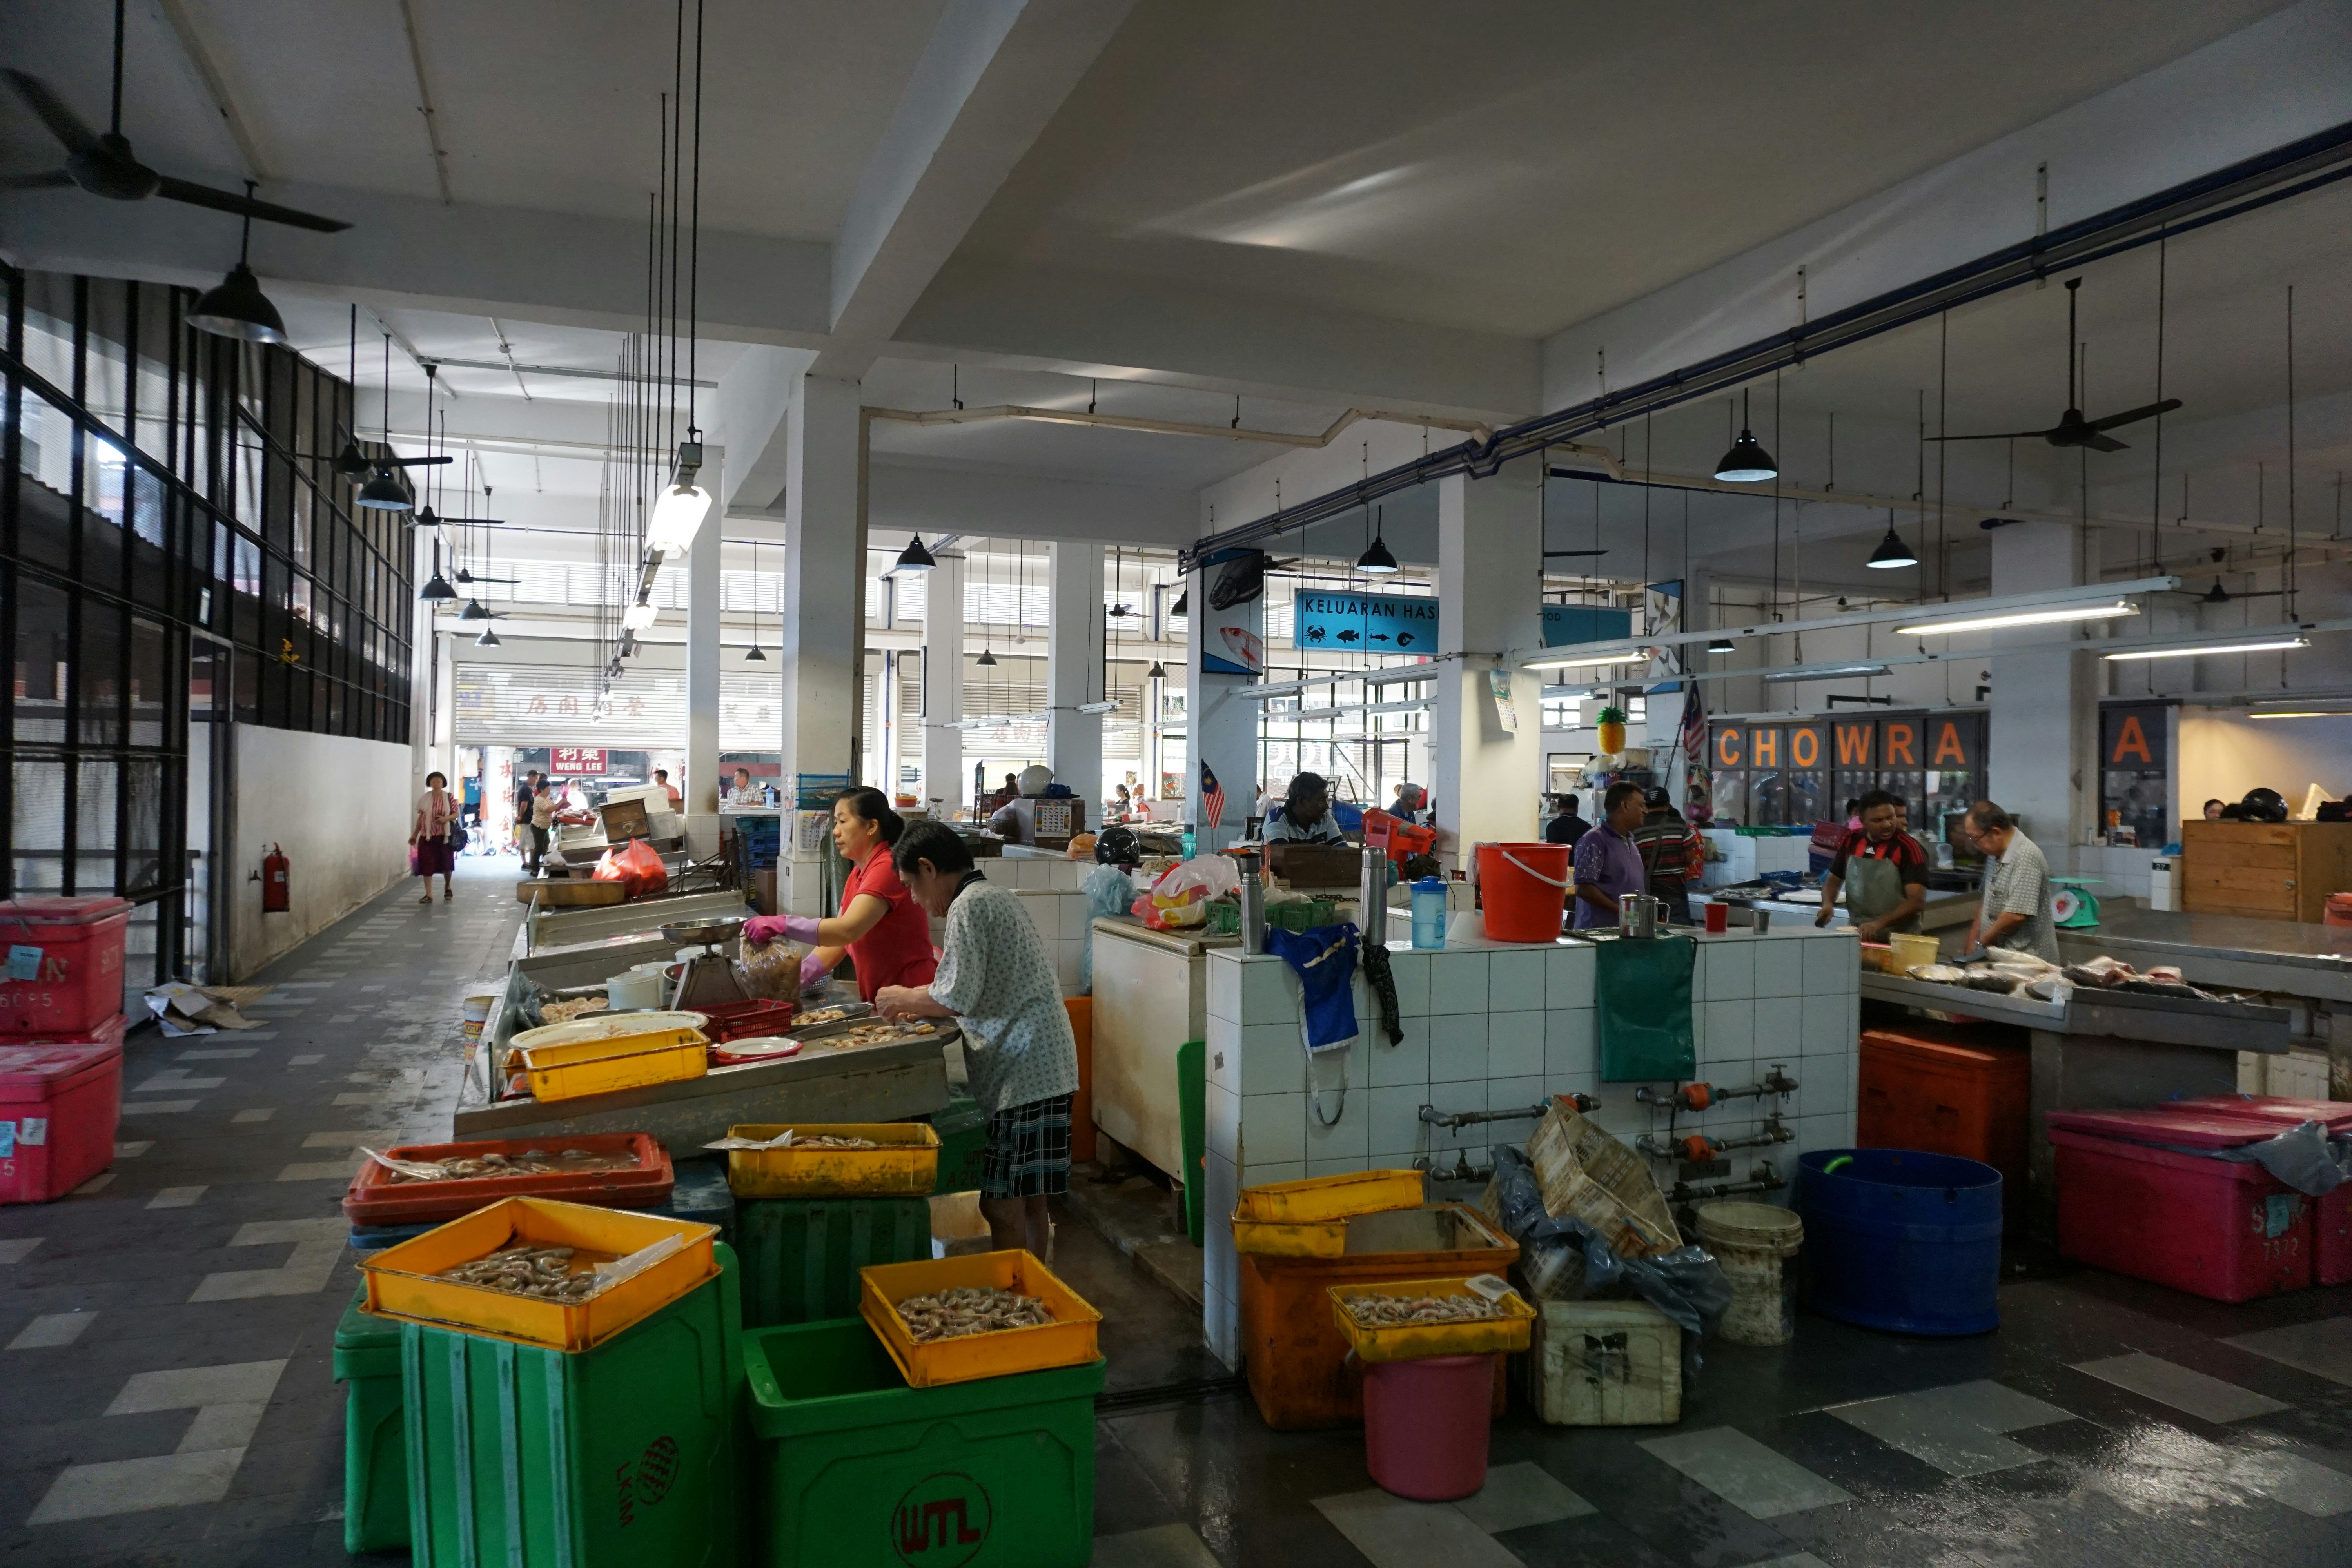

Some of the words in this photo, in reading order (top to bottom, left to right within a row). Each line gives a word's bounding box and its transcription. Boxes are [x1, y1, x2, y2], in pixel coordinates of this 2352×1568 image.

[1305, 598, 1395, 617] KELUARAN
[1403, 604, 1436, 620] HAS
[555, 762, 582, 771] WENG
[586, 762, 602, 771] LEE
[901, 1497, 980, 1554] WTL
